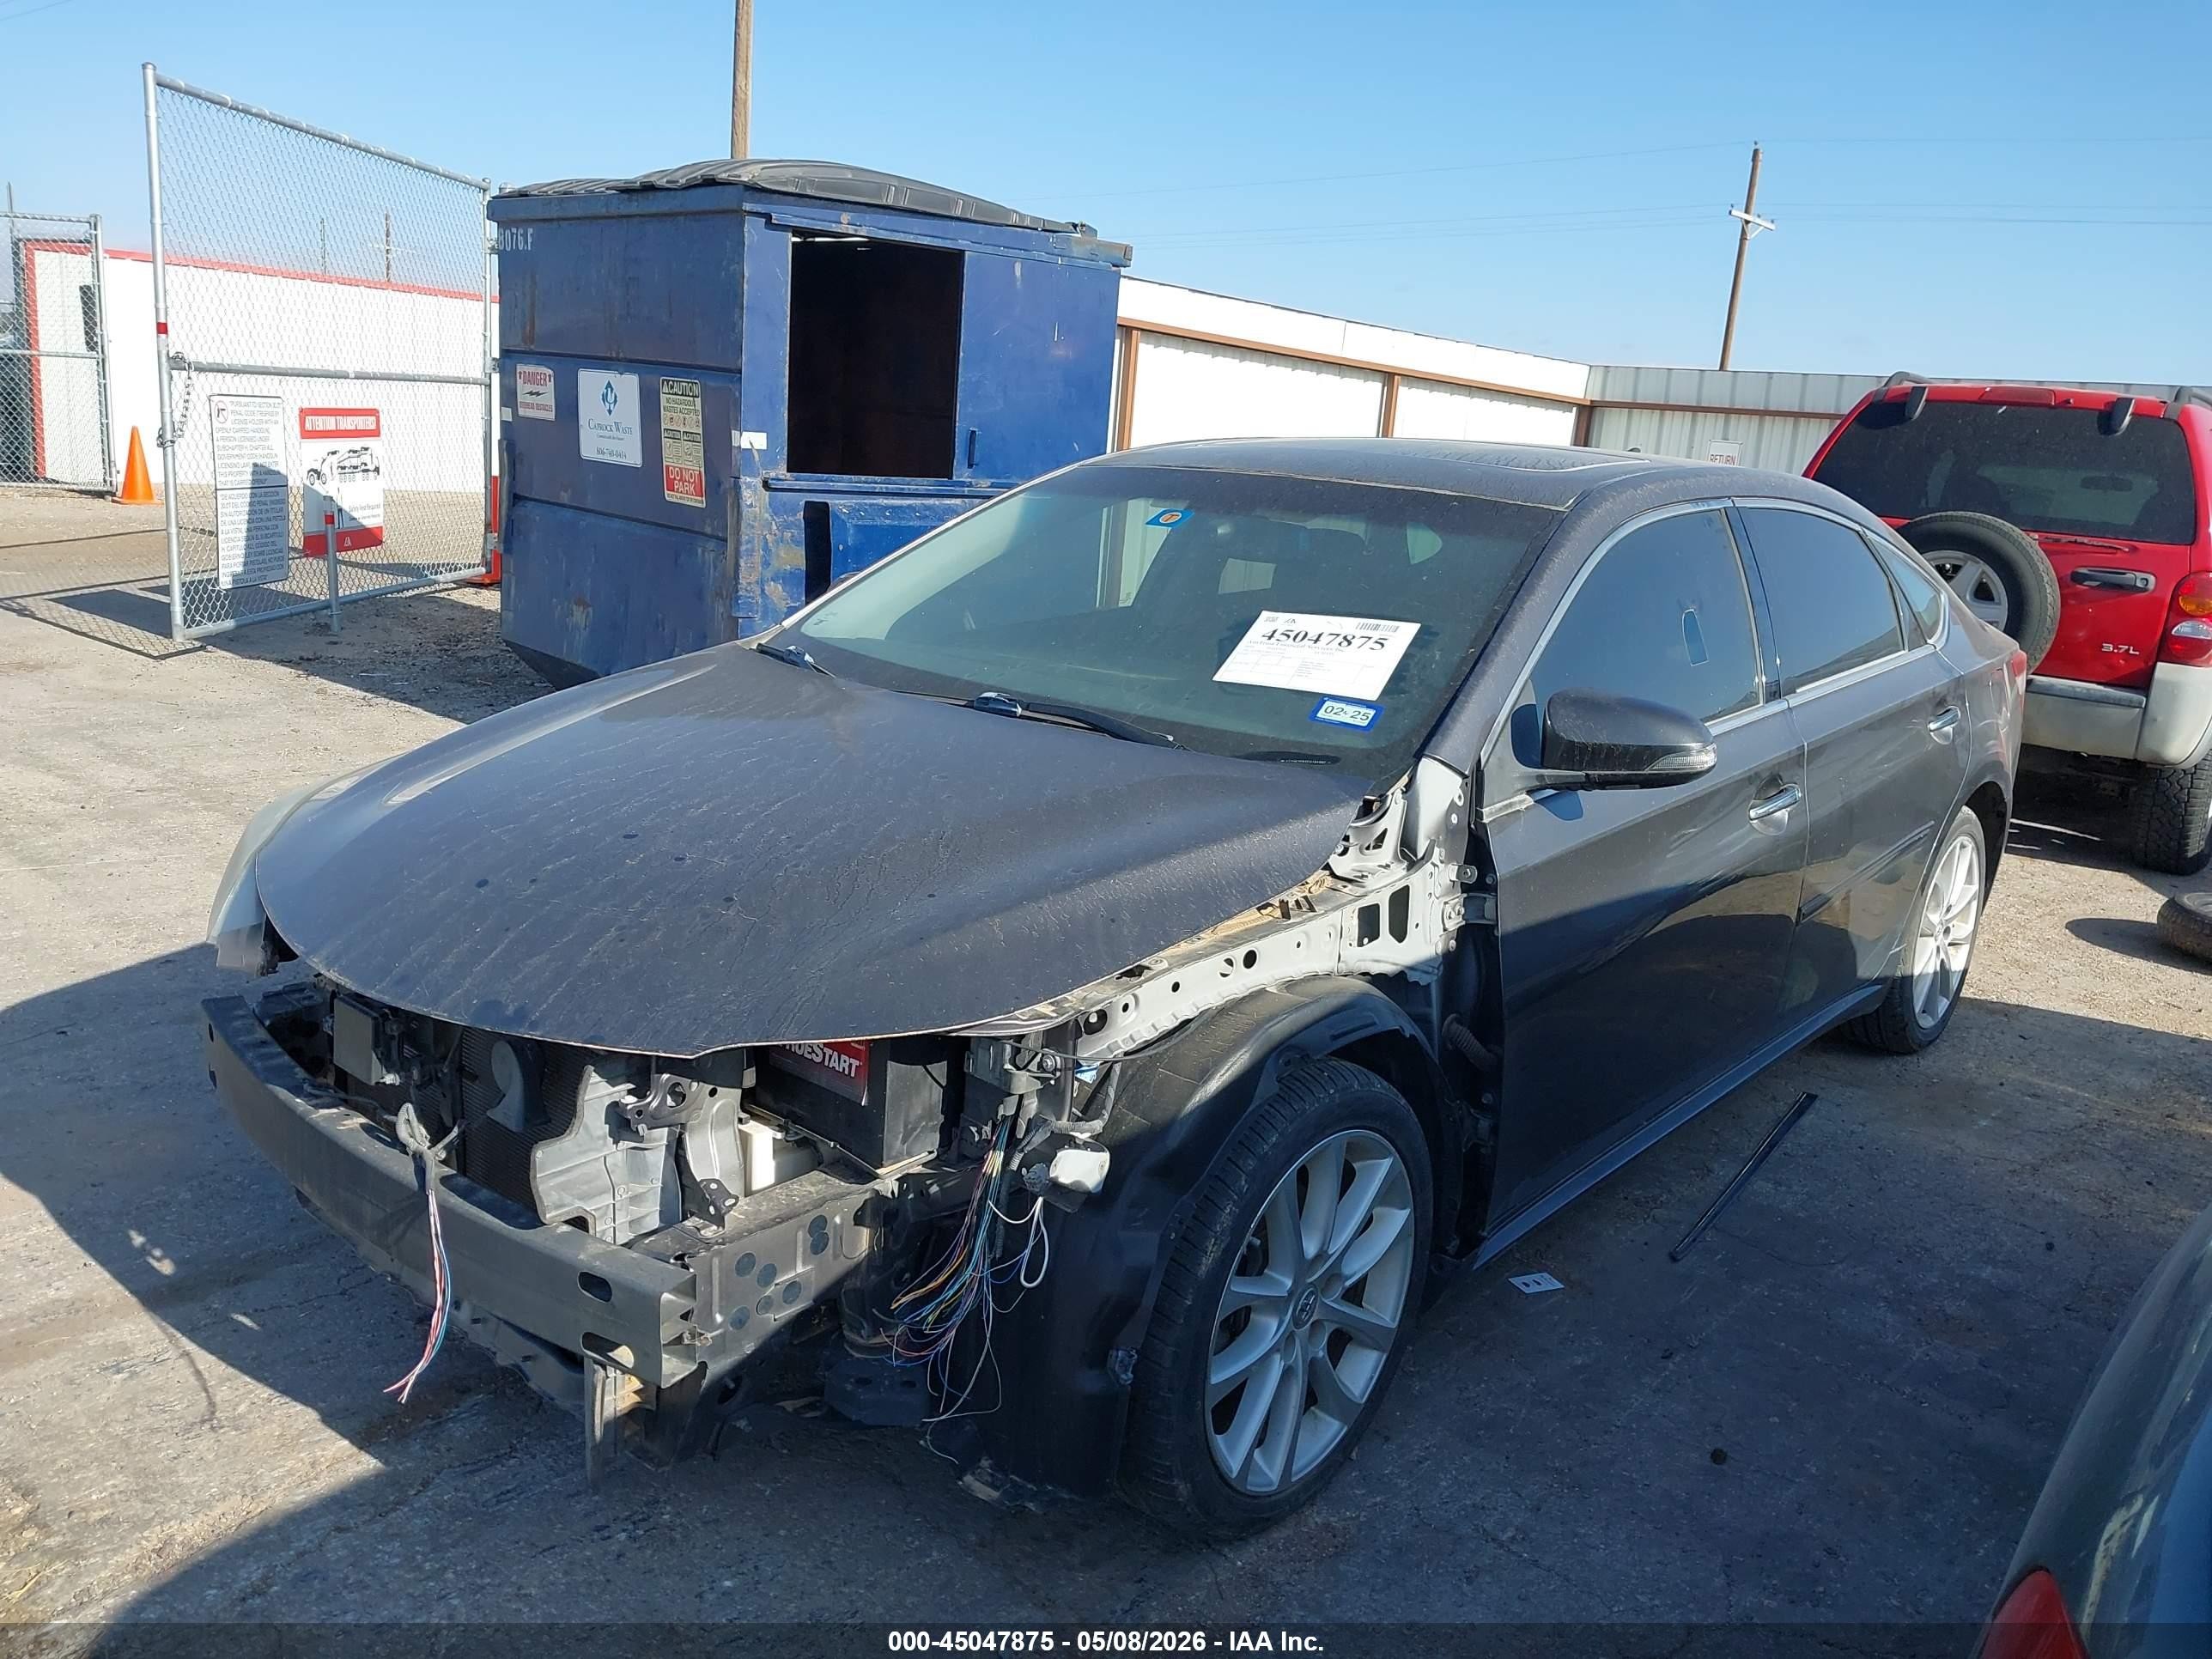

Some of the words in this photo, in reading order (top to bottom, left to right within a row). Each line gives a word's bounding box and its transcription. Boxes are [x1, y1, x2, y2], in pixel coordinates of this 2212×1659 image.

[522, 371, 548, 386] DANGER
[667, 380, 699, 397] CAUTION
[613, 421, 633, 434] WASTE
[669, 466, 681, 480] DO
[683, 468, 700, 484] NOT
[674, 480, 696, 495] PARK
[1261, 628, 1389, 651] 45047875
[2101, 643, 2140, 655] 3.7L
